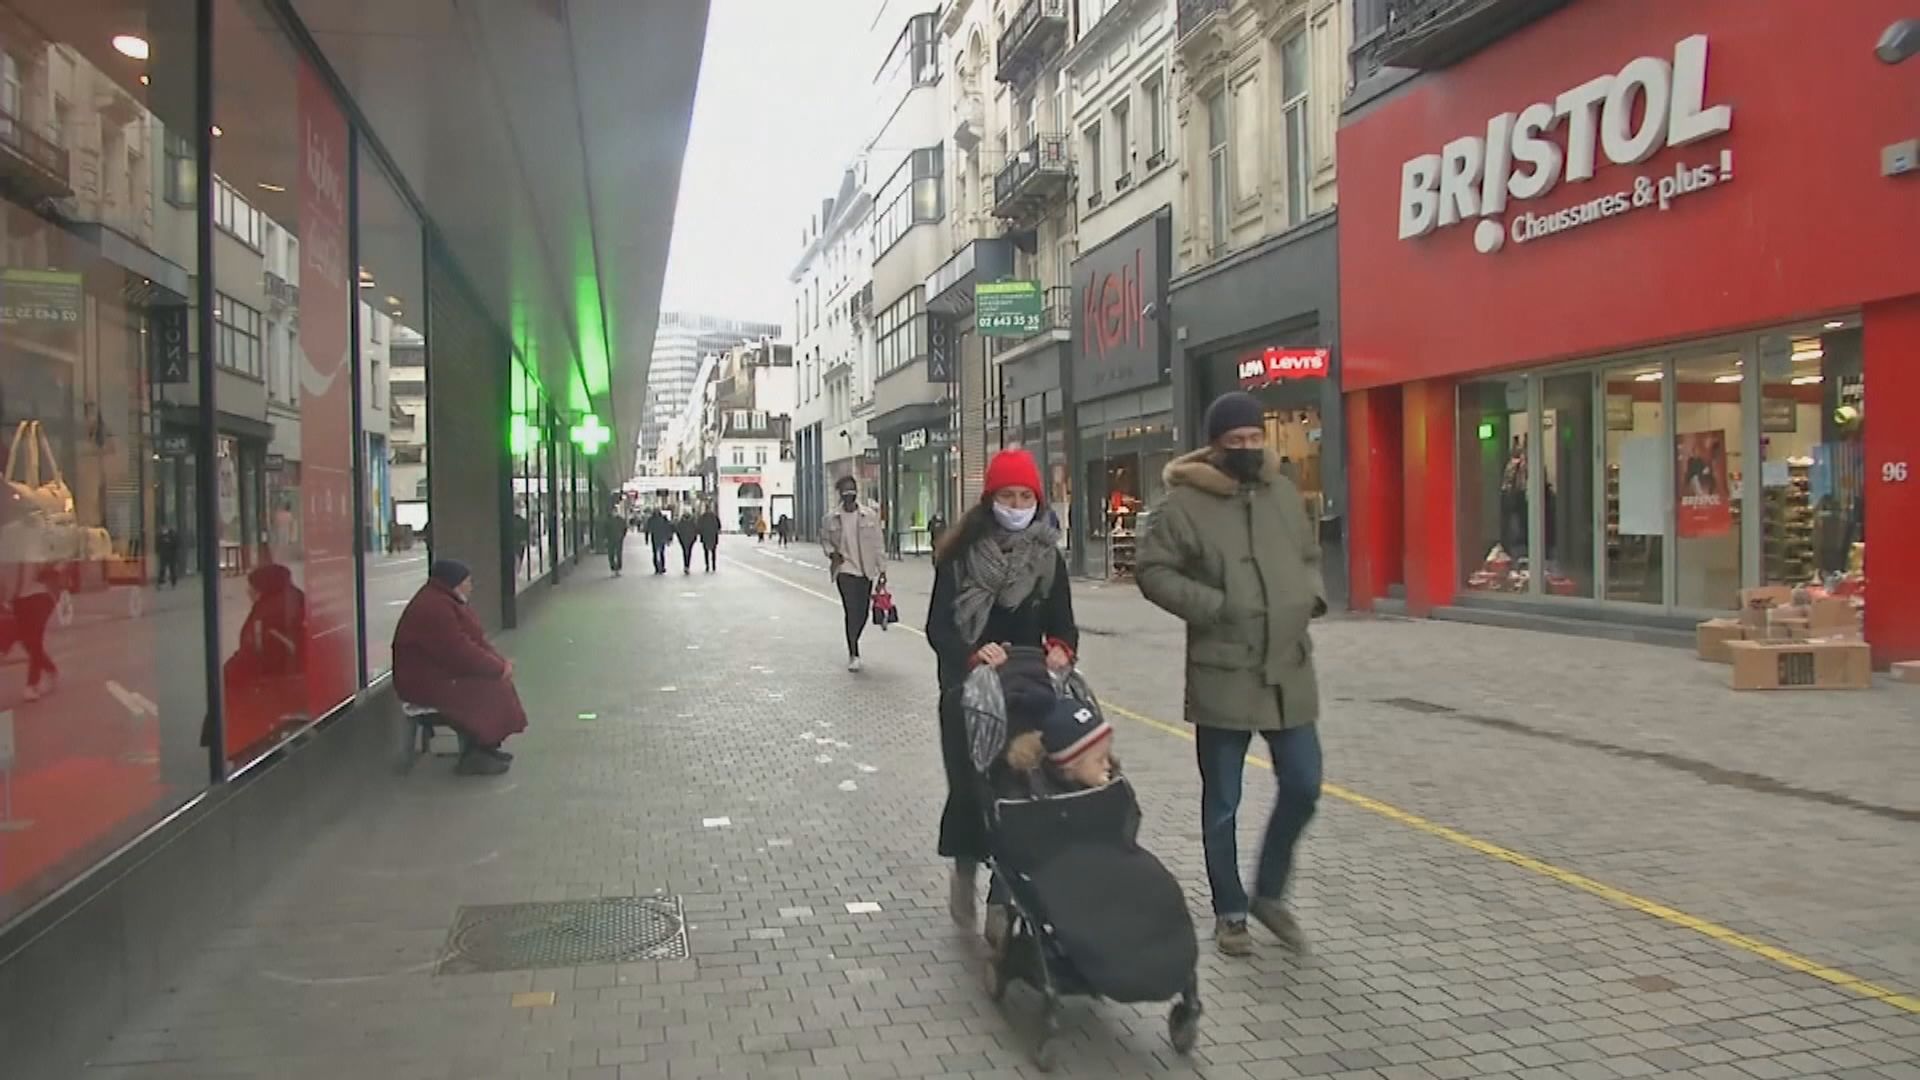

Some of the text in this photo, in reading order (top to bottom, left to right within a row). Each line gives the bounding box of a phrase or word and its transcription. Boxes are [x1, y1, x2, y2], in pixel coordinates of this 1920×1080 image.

[1511, 150, 1733, 243] Chaussures & plus !
[979, 314, 1040, 328] 02 643 35 35
[1882, 461, 1907, 481] 96
